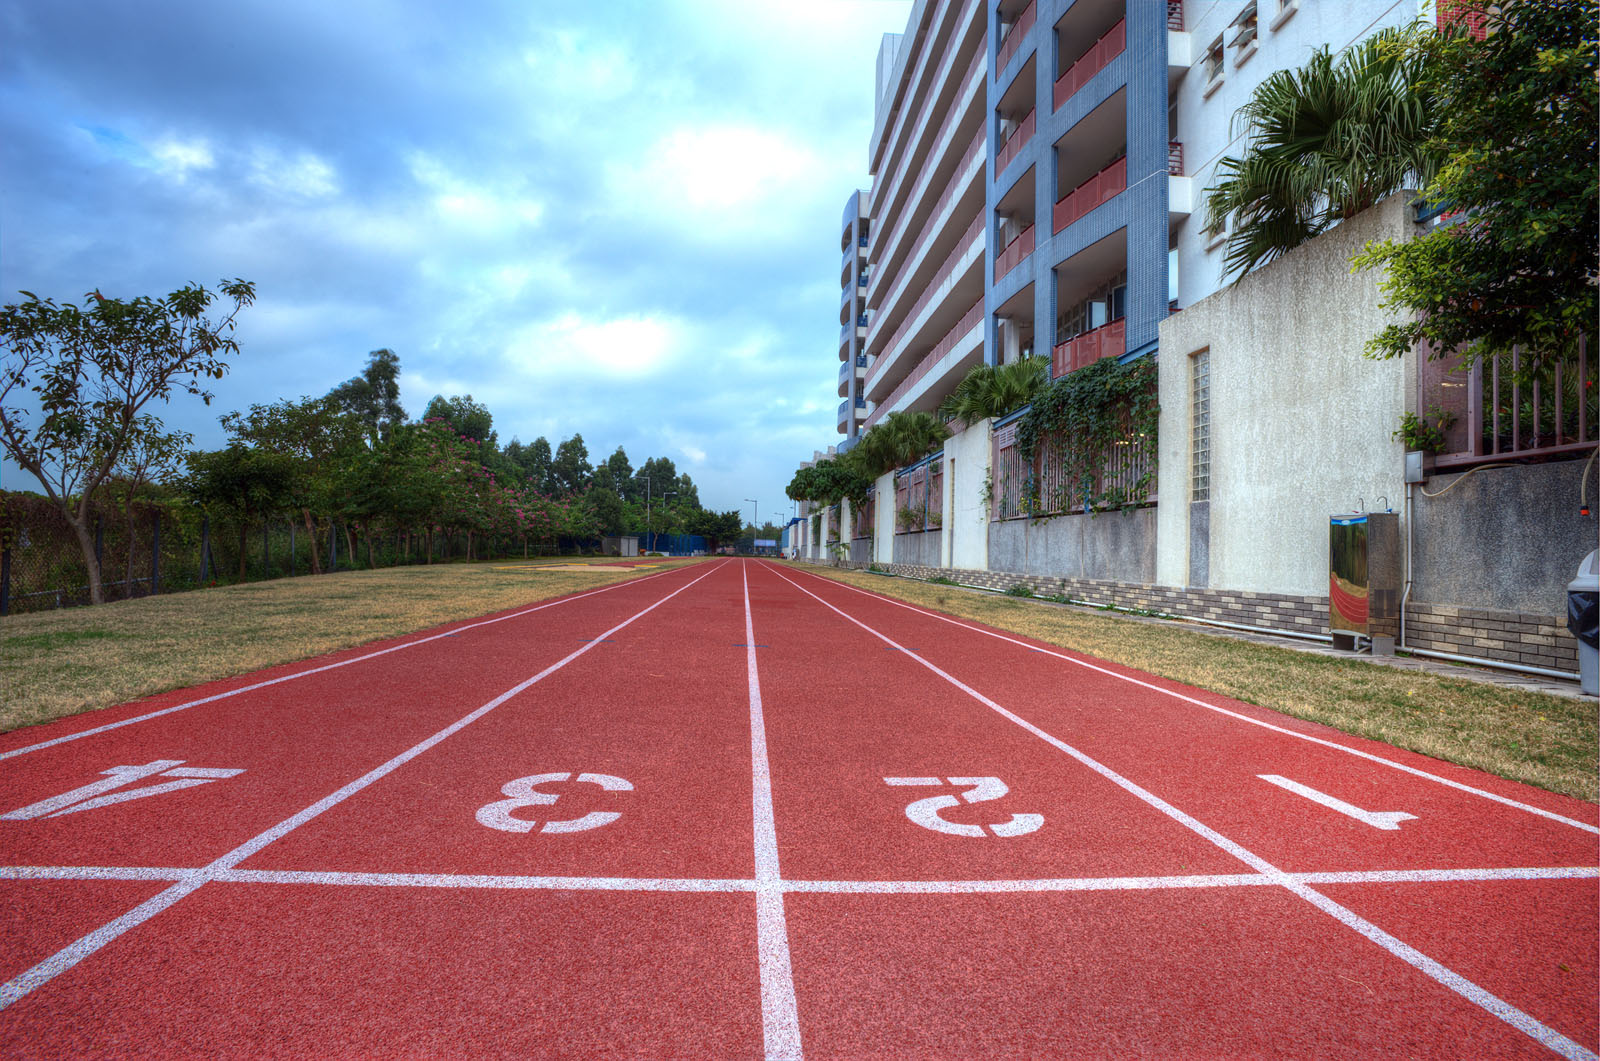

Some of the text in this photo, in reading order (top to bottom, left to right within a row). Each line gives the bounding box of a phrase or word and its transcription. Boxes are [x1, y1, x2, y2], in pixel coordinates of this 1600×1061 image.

[0, 760, 248, 821] 4
[475, 772, 635, 835] 3
[883, 776, 1046, 838] 2
[1256, 774, 1420, 831] 1
